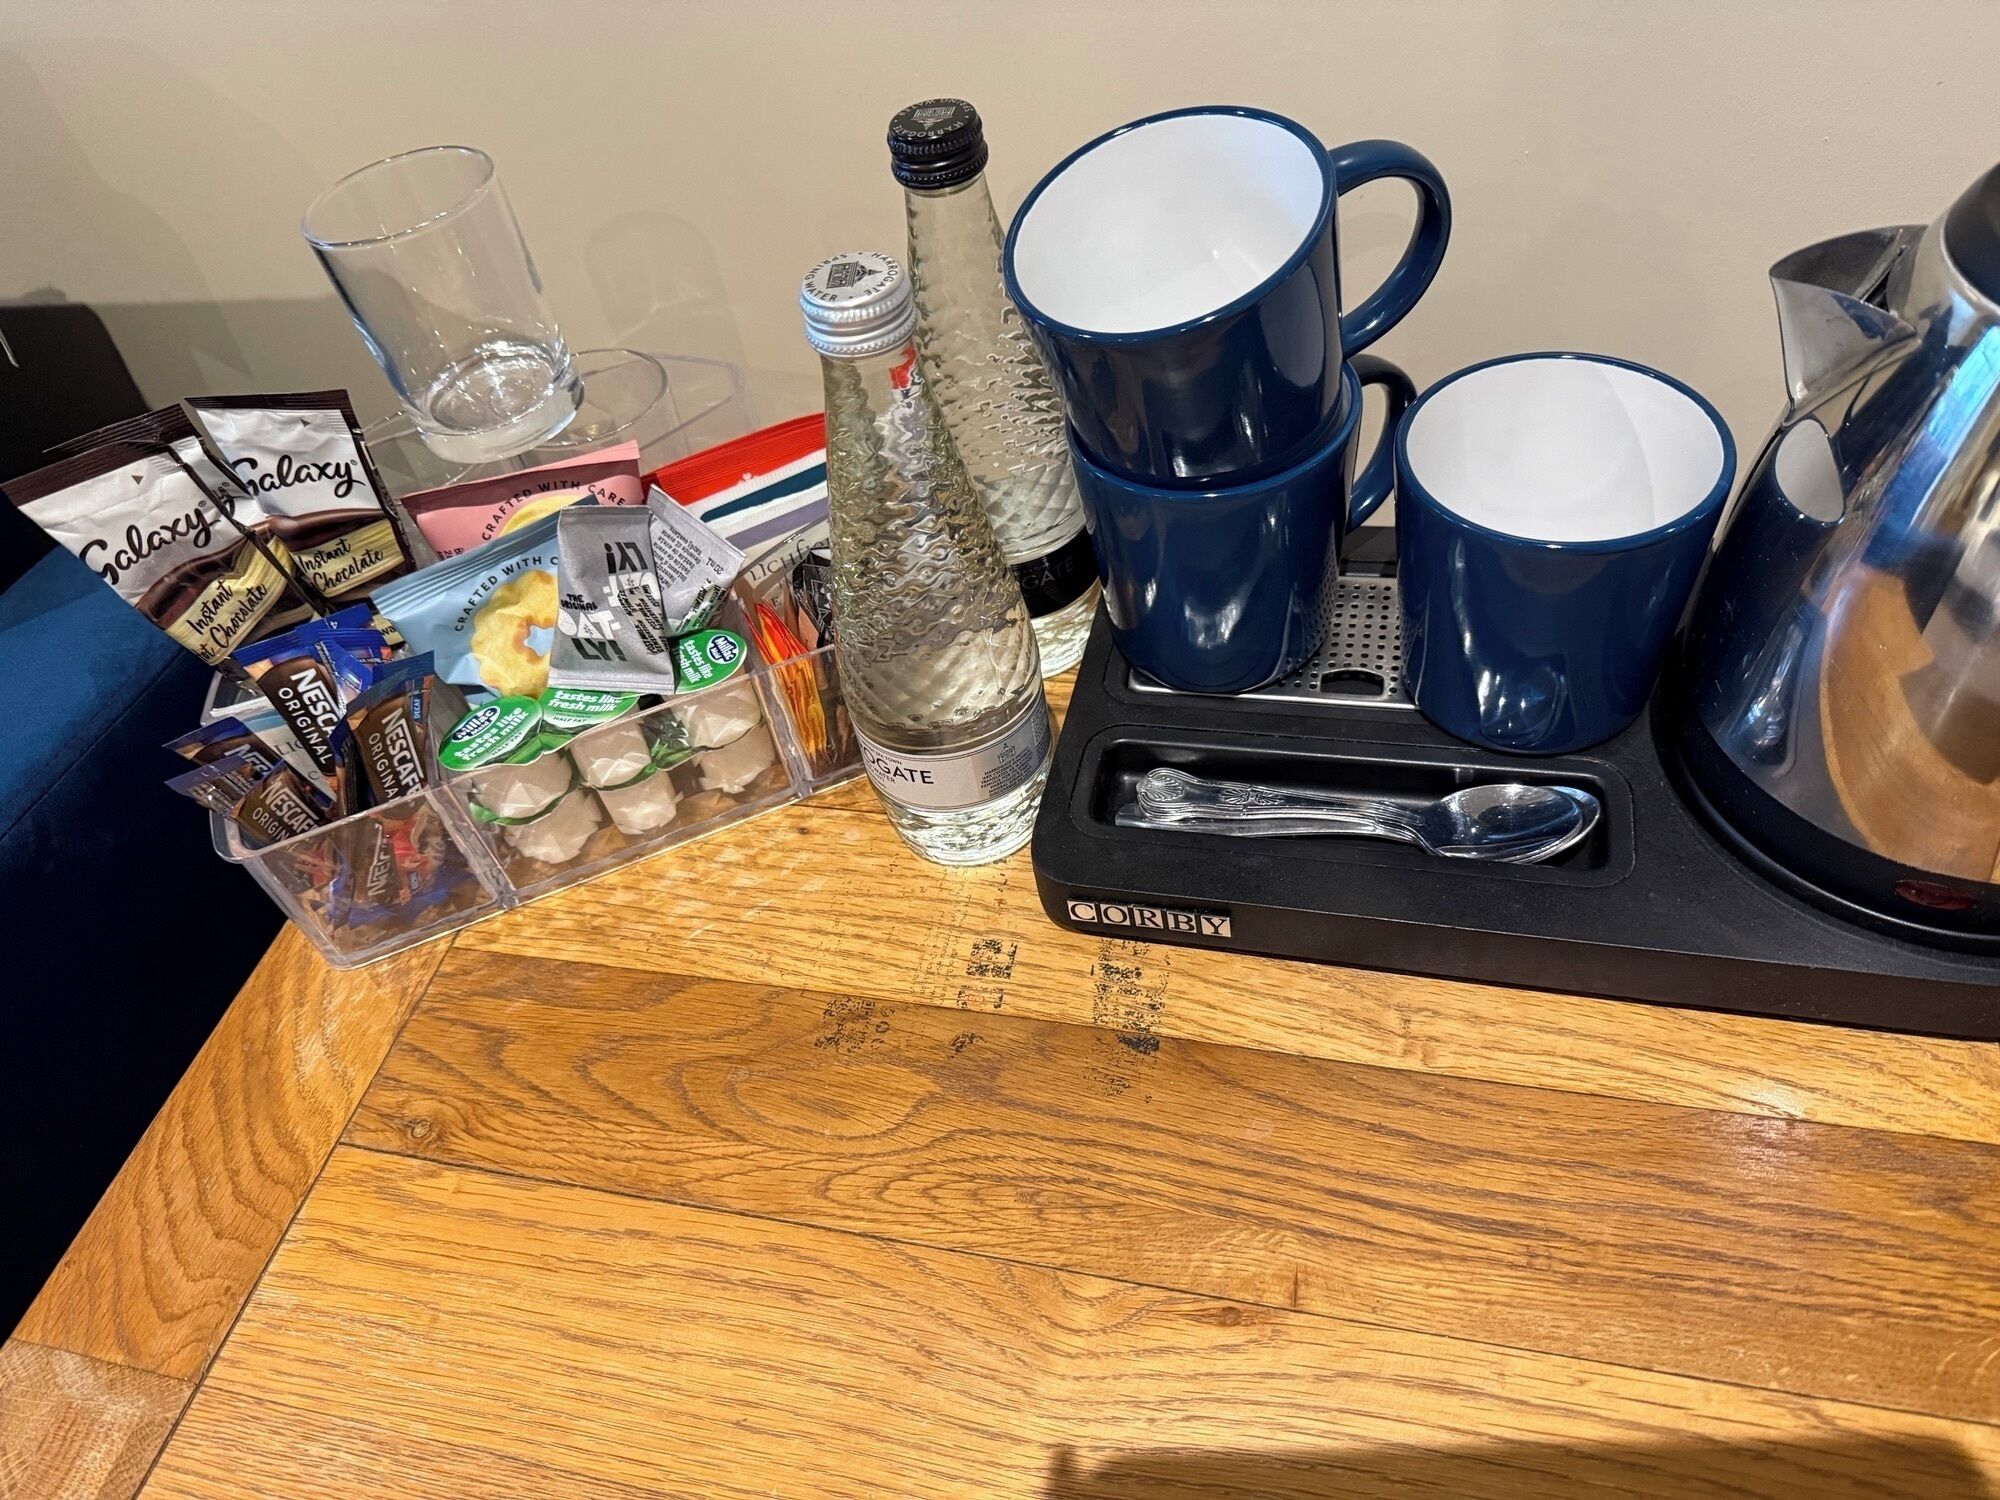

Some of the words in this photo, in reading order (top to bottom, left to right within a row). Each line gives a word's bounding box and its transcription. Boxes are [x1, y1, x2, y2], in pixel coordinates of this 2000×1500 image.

[893, 121, 965, 138] HARROGATE
[804, 254, 848, 281] SPRING
[862, 252, 899, 296] HARROGATE
[804, 282, 838, 302] WATER
[231, 454, 366, 498] Galaxy
[482, 488, 533, 541] CRAFTED
[537, 480, 580, 491] WITH
[588, 484, 625, 505] CARE
[80, 508, 221, 586] Galaxy
[298, 538, 352, 574] Instant
[312, 548, 384, 593] Chocolate
[186, 580, 233, 635] Instant
[454, 575, 498, 633] CRAFTED
[502, 556, 543, 576] WITH
[560, 600, 599, 612] ORIGINAL
[566, 593, 584, 603] THE
[210, 583, 267, 649] Chocolate
[571, 637, 628, 662] LY!
[684, 640, 705, 667] tastes
[698, 663, 713, 679] like
[683, 668, 702, 684] milk
[548, 698, 588, 712] fresh
[588, 701, 618, 712] milk
[554, 690, 598, 704] tastes
[598, 694, 623, 705] like
[277, 686, 334, 764] ORIGINAL
[454, 709, 493, 741] Millac
[454, 729, 498, 757] tastes
[496, 707, 522, 732] like
[462, 735, 502, 762] fresh
[502, 710, 529, 737] milk
[860, 744, 934, 785] OGATE
[1070, 902, 1227, 939] CORBY
